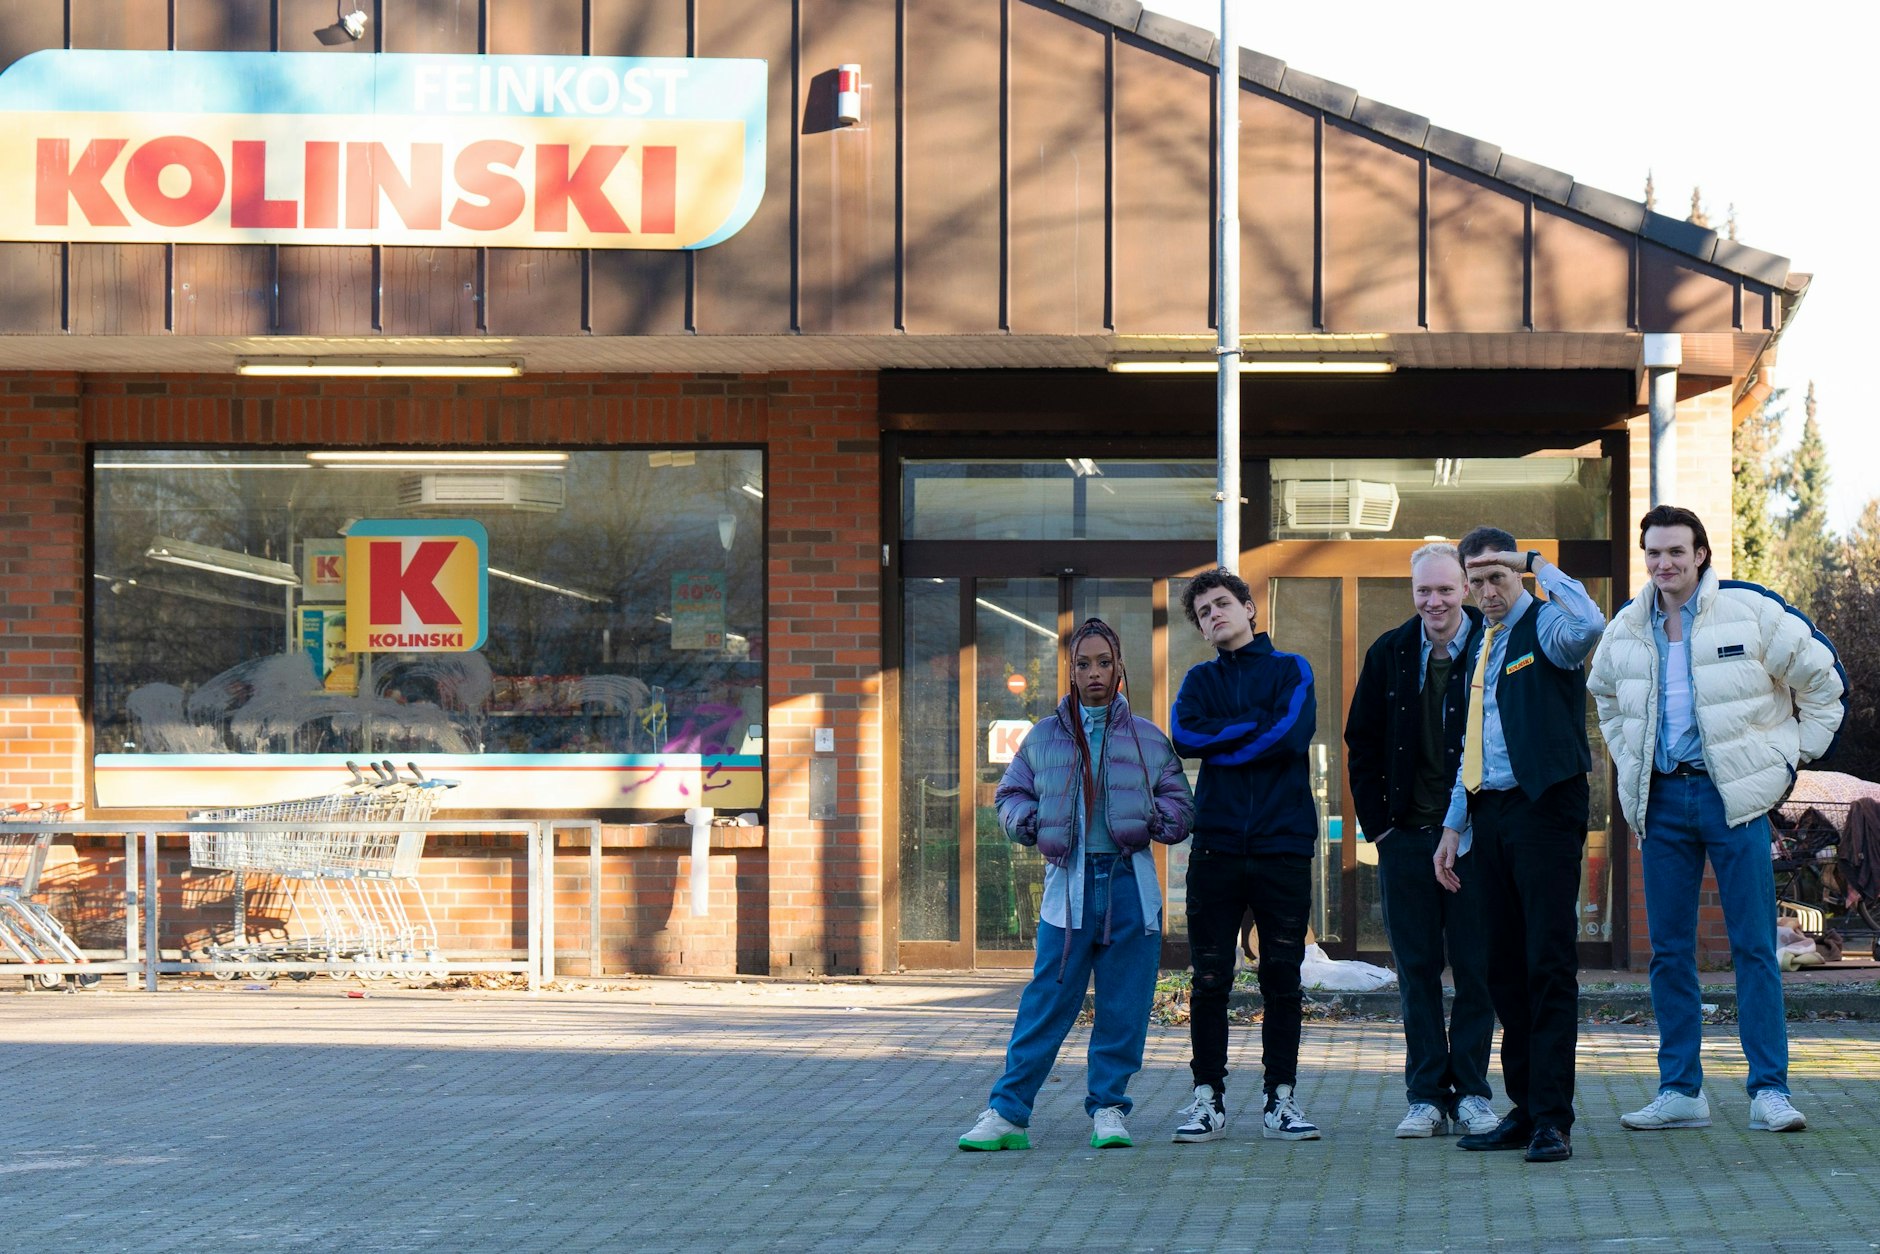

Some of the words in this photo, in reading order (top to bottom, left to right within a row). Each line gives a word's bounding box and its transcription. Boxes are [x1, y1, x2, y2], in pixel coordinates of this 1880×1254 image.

[415, 64, 690, 115] FEINKOST
[35, 135, 678, 235] KOLINSKI
[317, 556, 341, 578] K
[369, 541, 463, 625] K
[369, 633, 463, 648] KOLINSKI
[997, 727, 1024, 754] K
